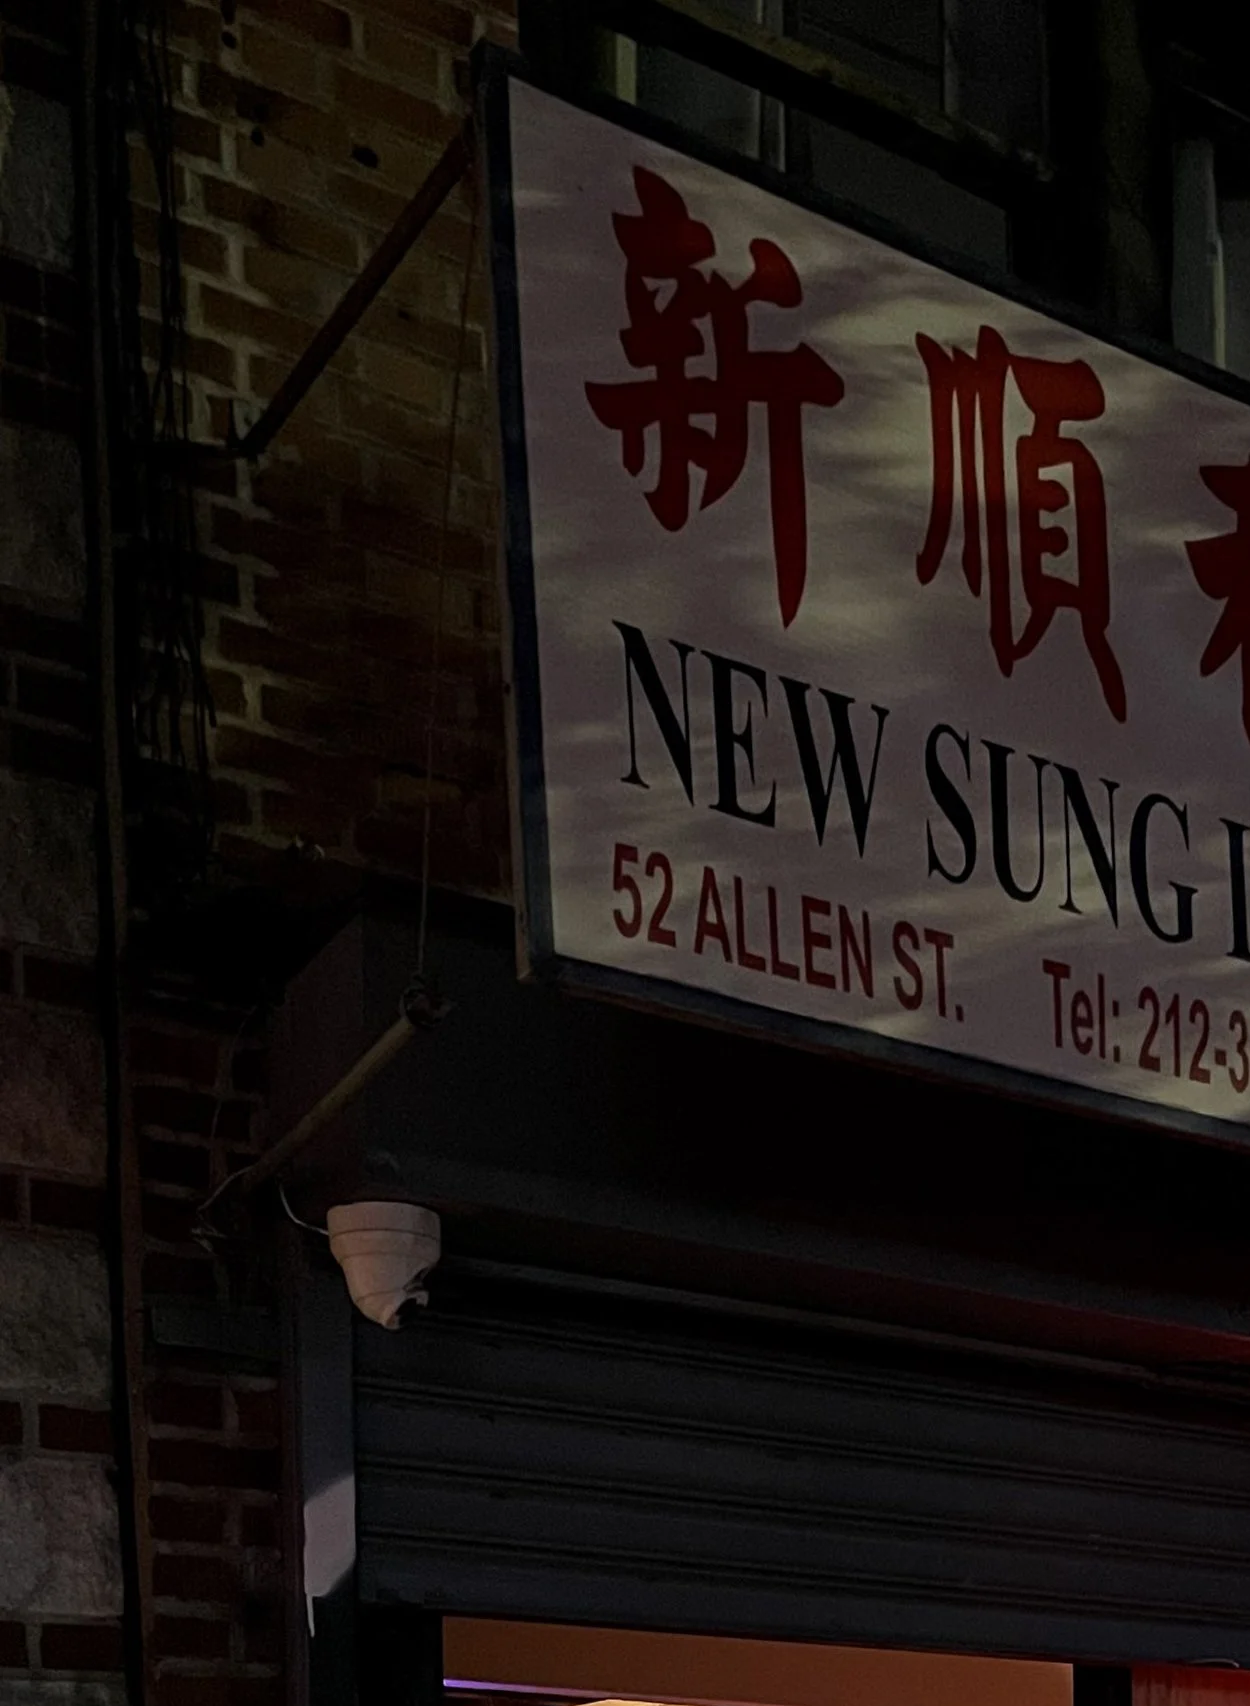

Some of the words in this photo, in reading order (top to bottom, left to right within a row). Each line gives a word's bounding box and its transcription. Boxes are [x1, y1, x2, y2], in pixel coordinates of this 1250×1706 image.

[612, 620, 890, 858] NEW
[924, 722, 1199, 945] SUNG
[612, 842, 677, 948] 52
[693, 866, 875, 998] ALLEN
[893, 920, 965, 1022] ST.
[1042, 958, 1122, 1064] Tel:
